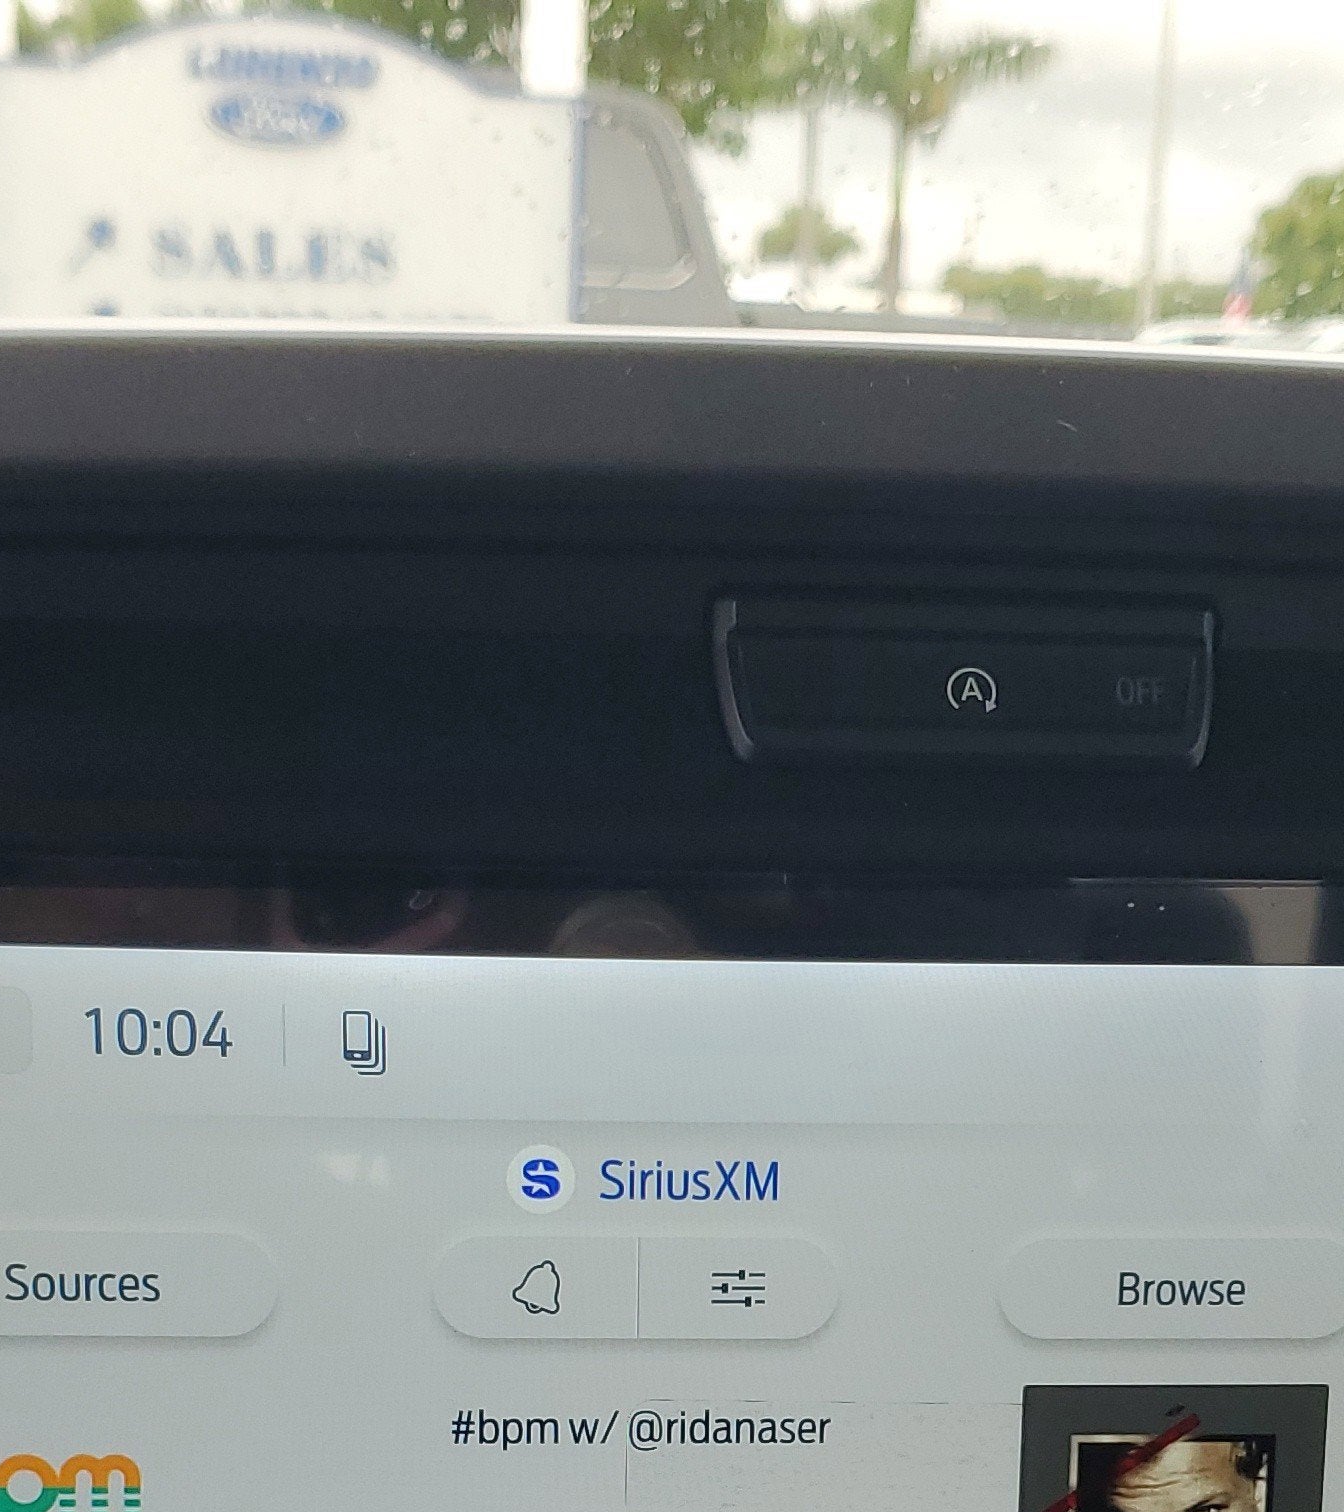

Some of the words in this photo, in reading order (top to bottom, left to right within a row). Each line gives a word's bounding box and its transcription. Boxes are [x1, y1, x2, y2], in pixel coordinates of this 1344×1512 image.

[150, 226, 396, 284] SALES
[84, 1007, 234, 1058] 10:04
[599, 1159, 781, 1202] SiriusXM
[4, 1263, 162, 1303] Sources
[1117, 1271, 1247, 1307] Browse
[451, 1409, 559, 1451] #bpm
[569, 1409, 619, 1445] w/
[628, 1408, 832, 1451] @ridanaser
